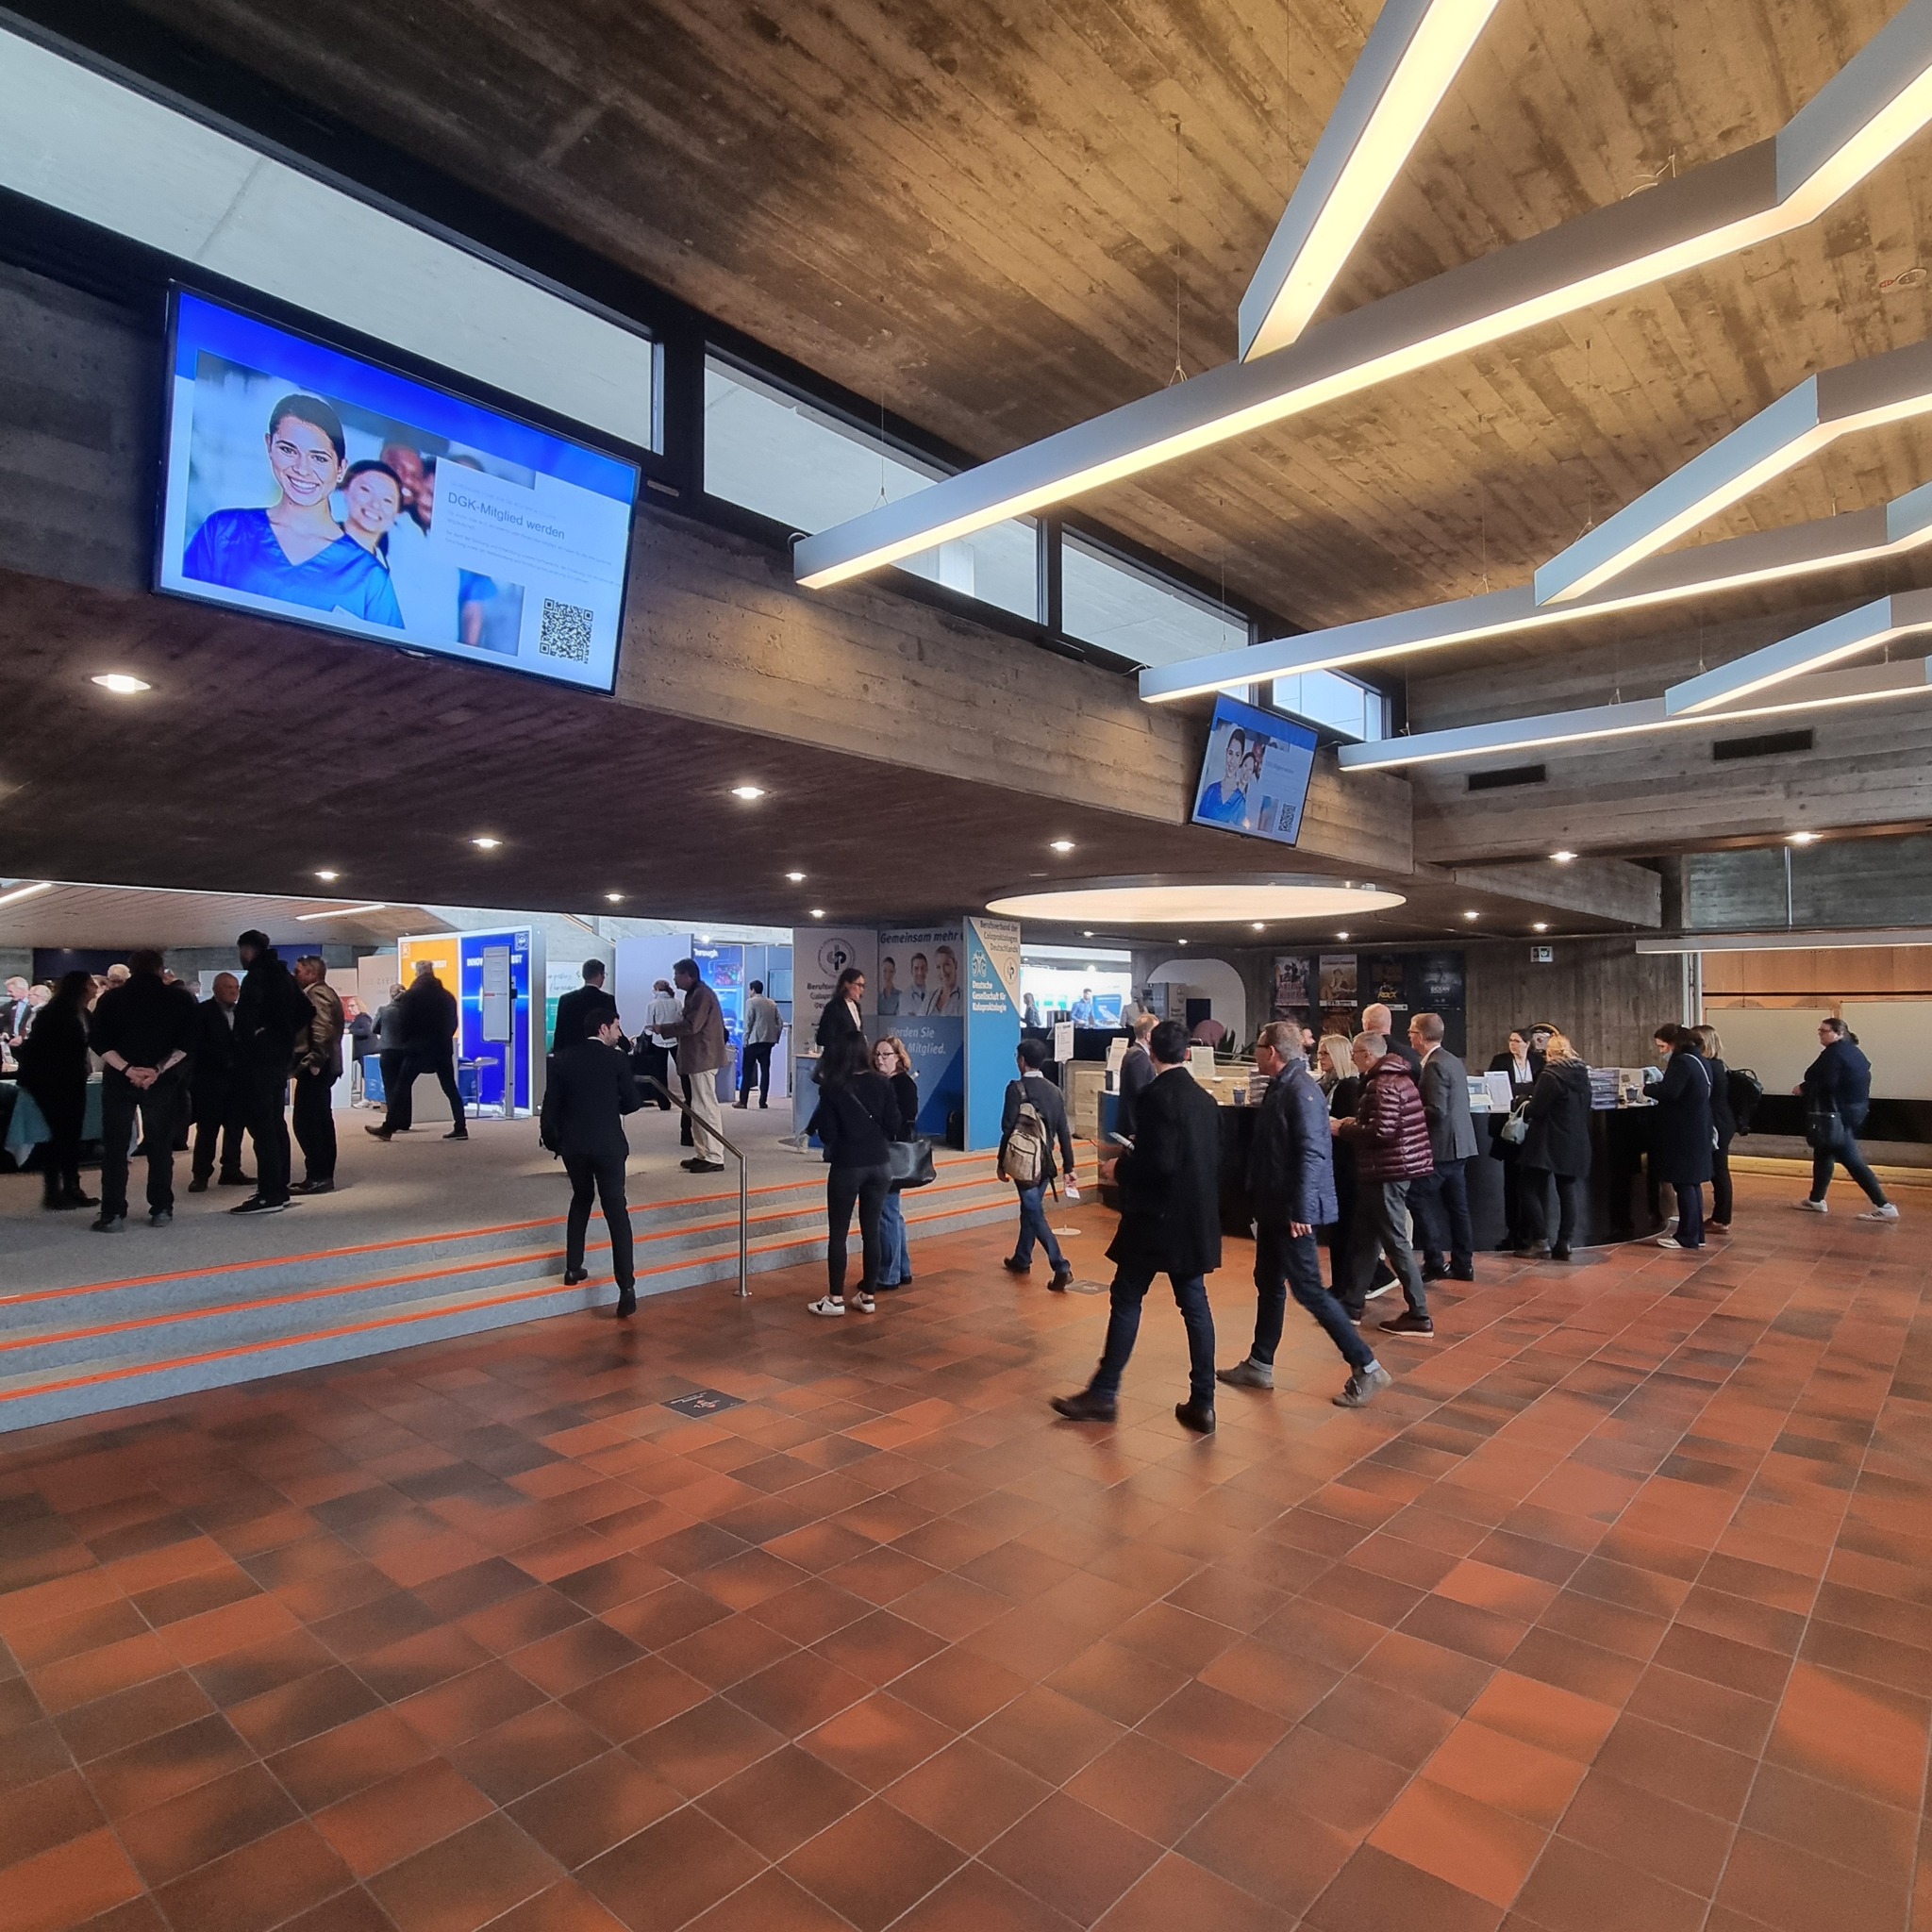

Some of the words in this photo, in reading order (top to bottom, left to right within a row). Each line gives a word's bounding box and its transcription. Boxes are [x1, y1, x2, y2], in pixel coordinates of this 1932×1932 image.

[448, 491, 523, 525] DGK-Mitglied
[525, 520, 565, 540] werden
[880, 932, 931, 943] Gemeinsam
[933, 930, 958, 941] mehr
[888, 1026, 918, 1038] Werden
[921, 1025, 935, 1038] Sie
[908, 1041, 946, 1056] Mitglied.
